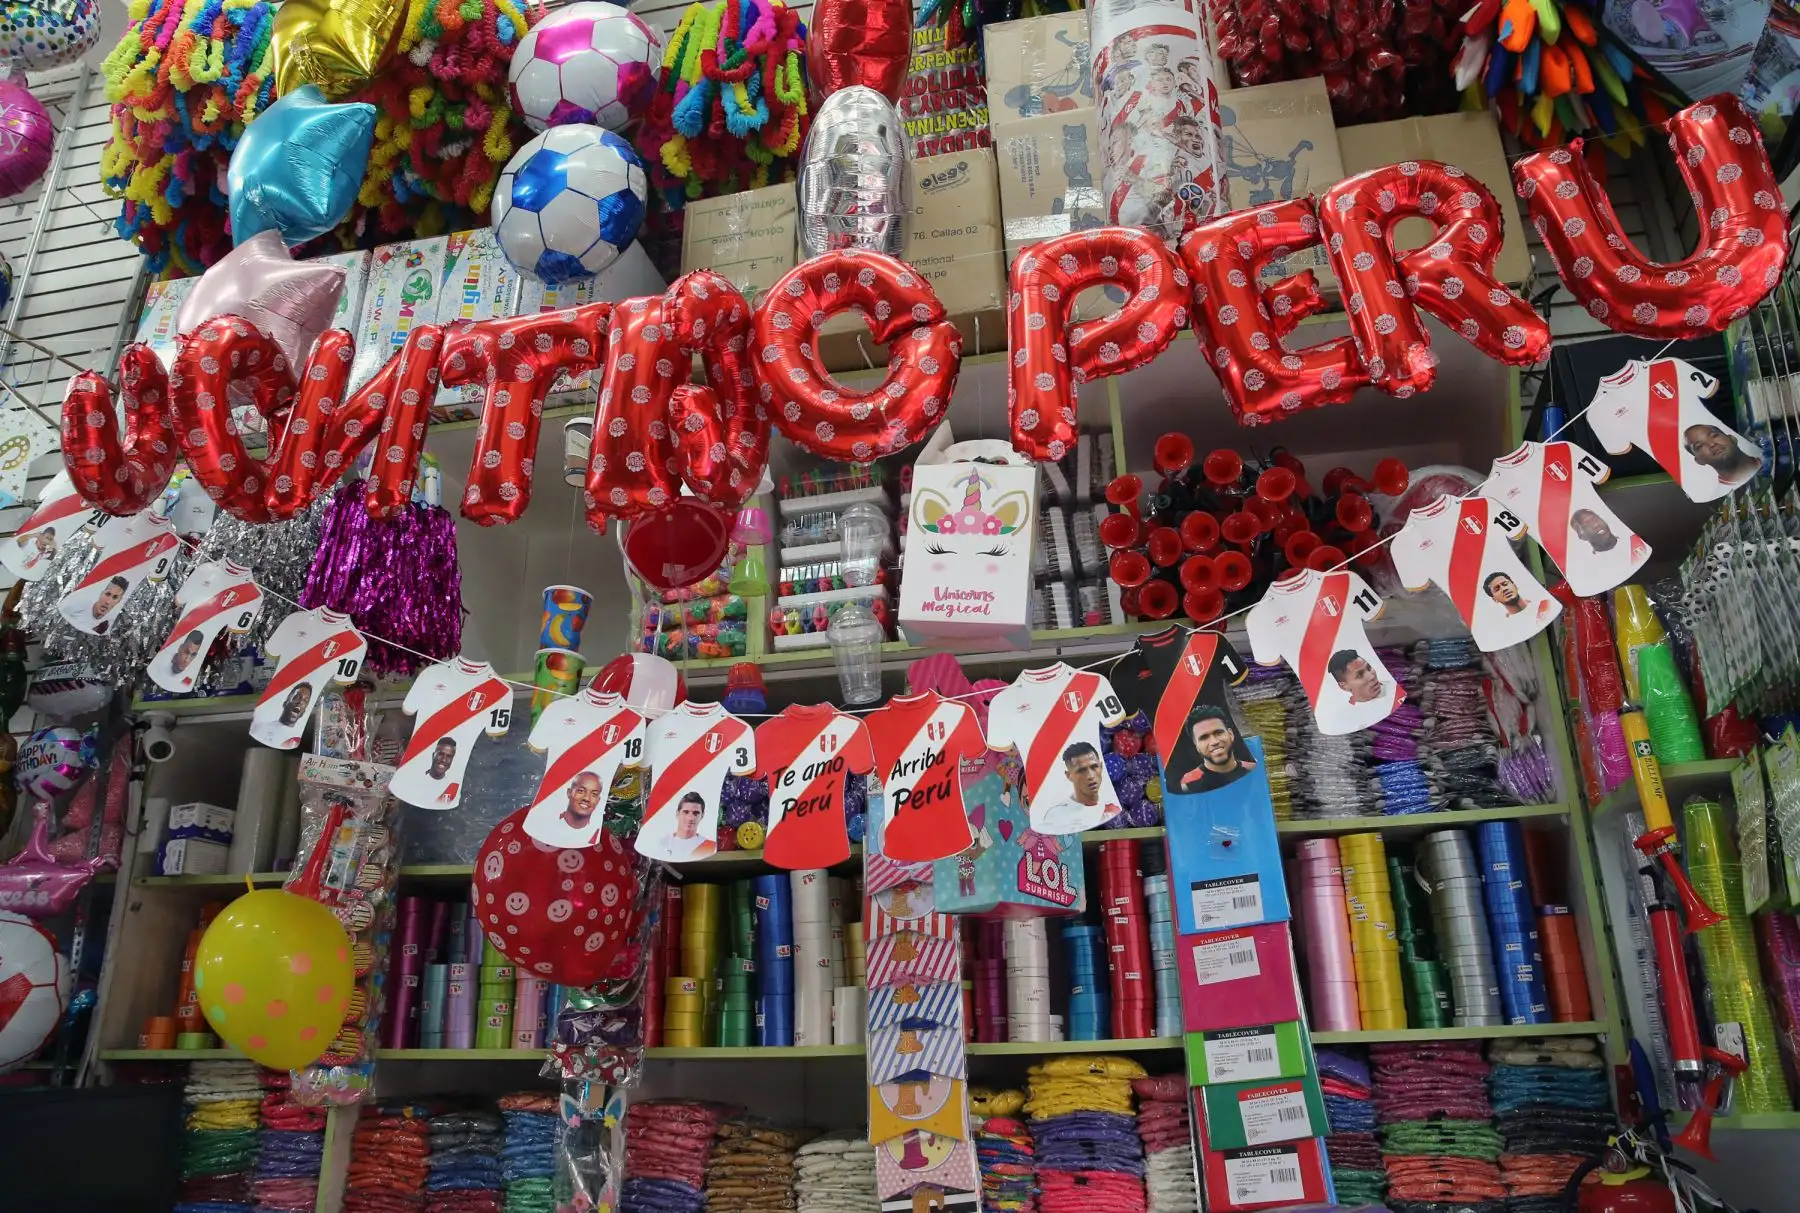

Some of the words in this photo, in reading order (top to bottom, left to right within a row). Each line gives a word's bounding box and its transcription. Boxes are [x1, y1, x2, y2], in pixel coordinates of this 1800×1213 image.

[931, 228, 963, 239] Callao
[965, 225, 978, 234] 02
[1008, 92, 1790, 462] PERU
[1690, 371, 1714, 389] 2
[1577, 455, 1602, 476] 17
[87, 510, 110, 528] 20
[1493, 510, 1521, 531] 13
[155, 558, 167, 574] 9
[934, 586, 995, 602] Unicorns
[1353, 589, 1377, 613] 11
[922, 601, 991, 618] Magical
[237, 611, 252, 628] 6
[337, 658, 357, 677] 10
[1221, 655, 1238, 675] 1
[1100, 695, 1121, 718] 19
[490, 709, 510, 728] 15
[623, 739, 641, 758] 18
[735, 747, 748, 766] 3
[773, 767, 795, 788] Te
[803, 756, 844, 782] amo
[891, 748, 945, 780] Arriba
[782, 780, 835, 821] Perú
[892, 766, 954, 816] Perú
[1204, 878, 1244, 889] TABLECOVER
[1025, 883, 1068, 904] SURPRISE!
[1201, 933, 1239, 945] TABLECOVER
[1217, 1029, 1259, 1039] TABLECOVER
[1247, 1088, 1288, 1099] TABLECOVER
[1239, 1148, 1282, 1158] TABLECOVER
